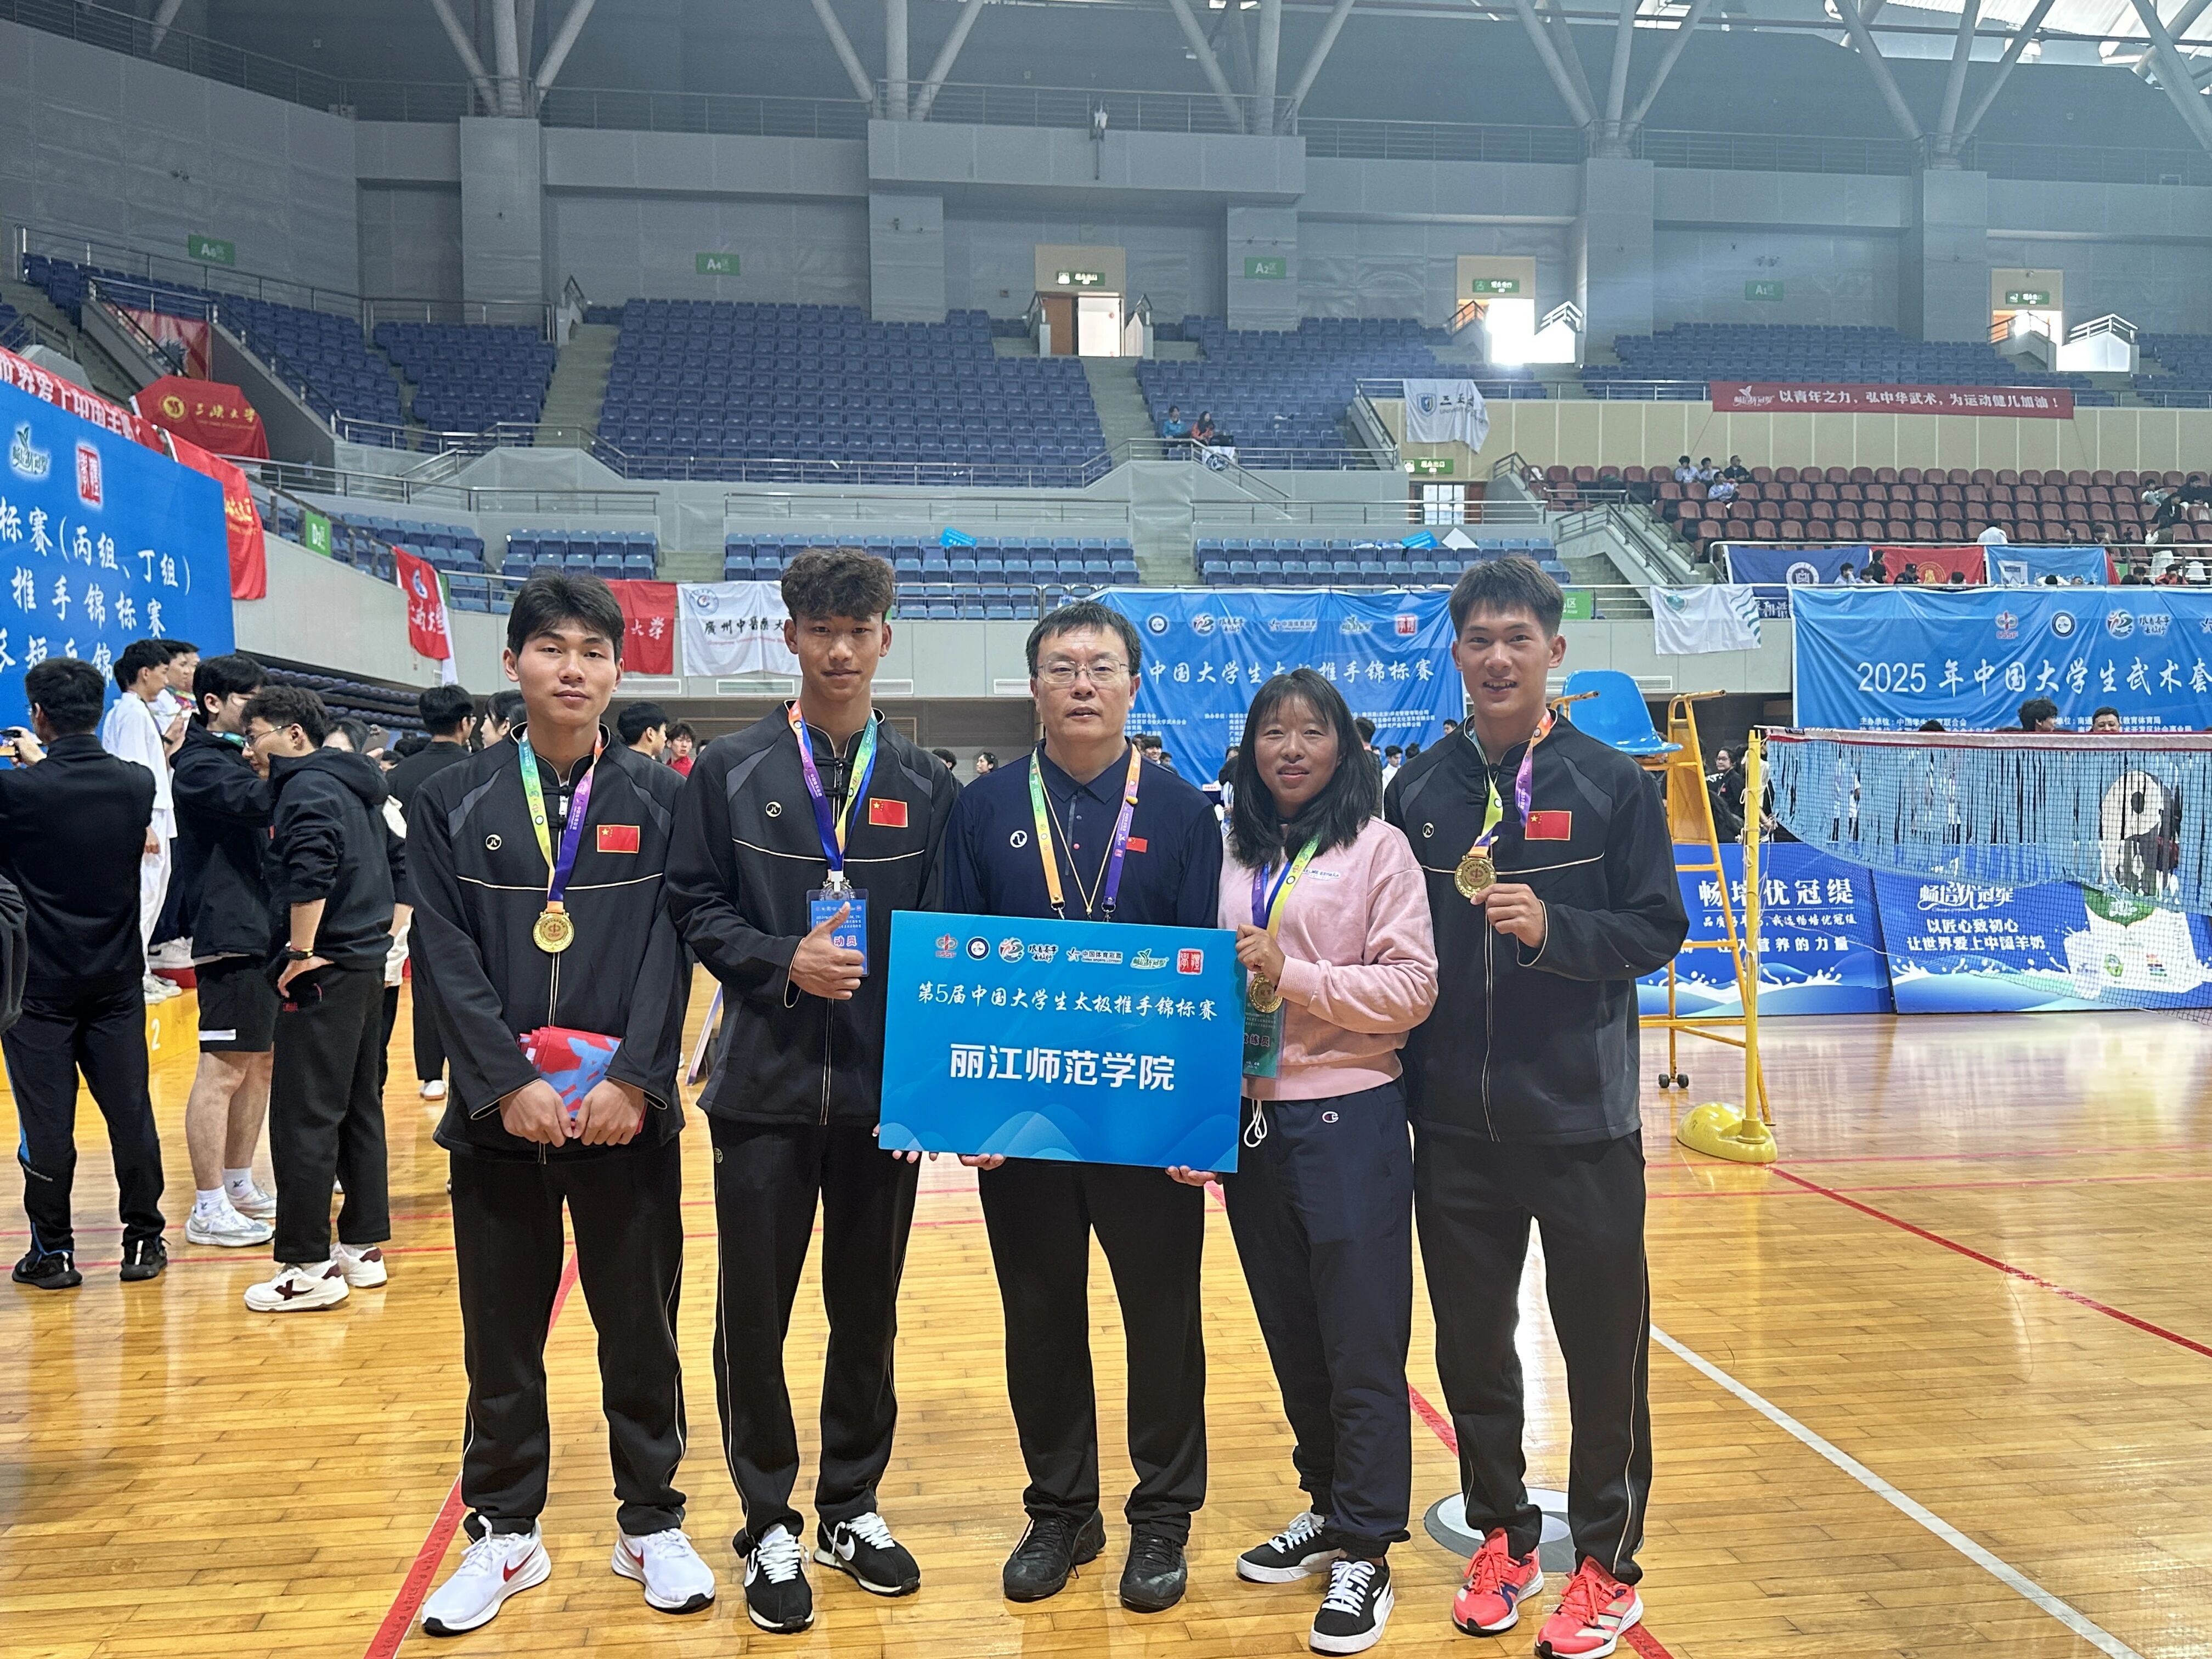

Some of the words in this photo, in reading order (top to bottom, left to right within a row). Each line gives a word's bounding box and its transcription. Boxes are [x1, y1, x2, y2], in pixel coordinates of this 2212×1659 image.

[10, 566, 166, 639] 推手锦标赛
[1906, 934, 2046, 951] 让世界爱上中国羊奶
[1926, 917, 2019, 934] 以匠心致初心
[917, 980, 1219, 1022] 第5届中国大学生太极推手锦标赛
[151, 1018, 161, 1051] 2
[950, 1043, 1176, 1091] 丽江师范学院
